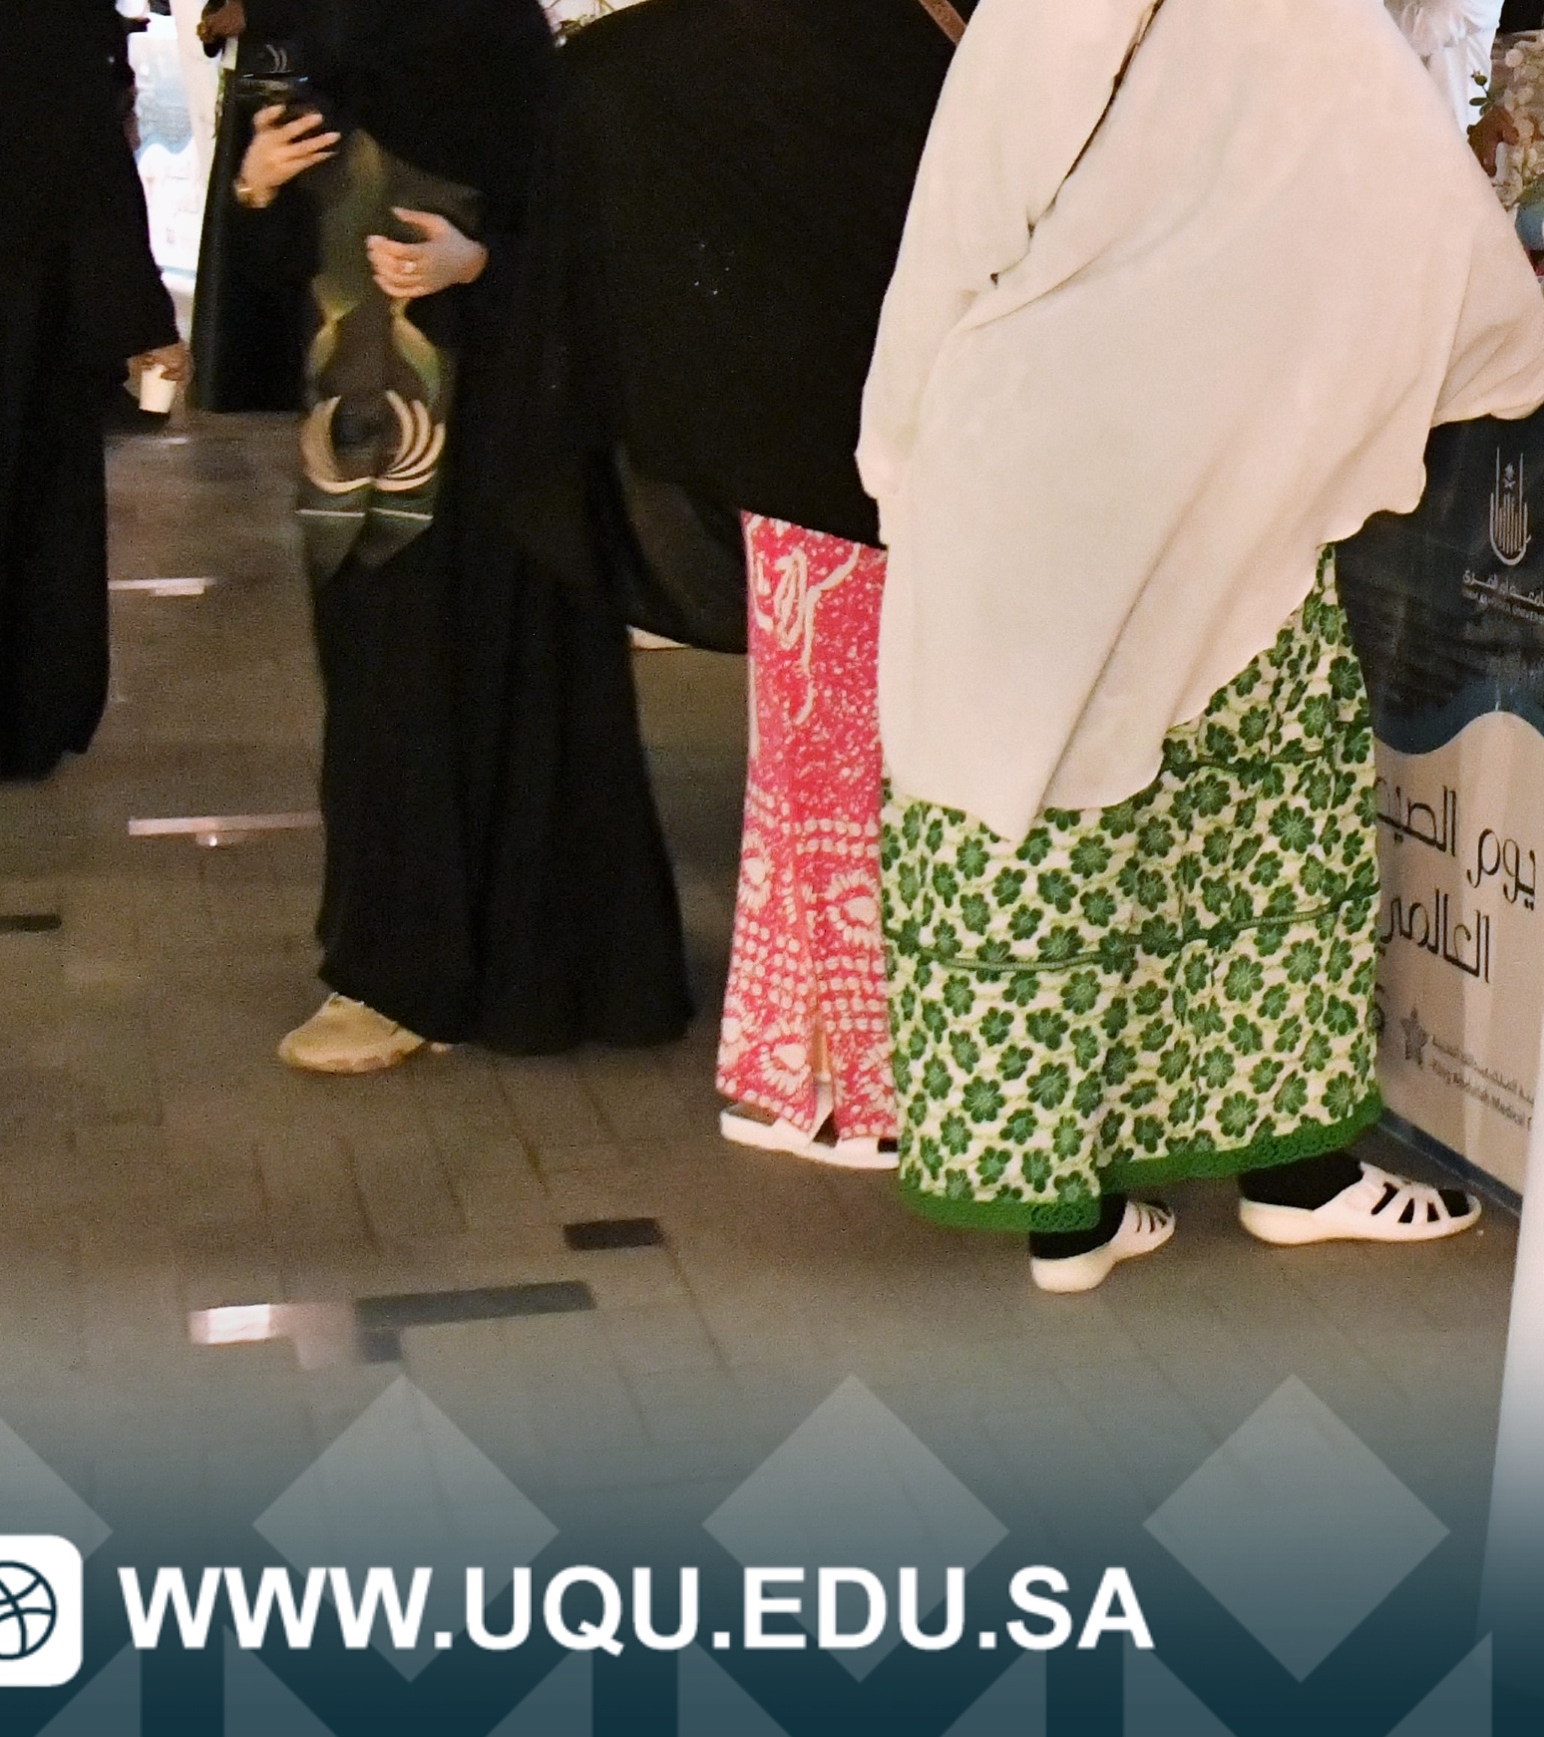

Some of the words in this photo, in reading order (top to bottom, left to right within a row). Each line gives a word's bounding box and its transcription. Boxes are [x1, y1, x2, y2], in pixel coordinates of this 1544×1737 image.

[1374, 776, 1456, 857] الصي
[1465, 828, 1537, 911] يوم
[1378, 887, 1492, 985] العالمي
